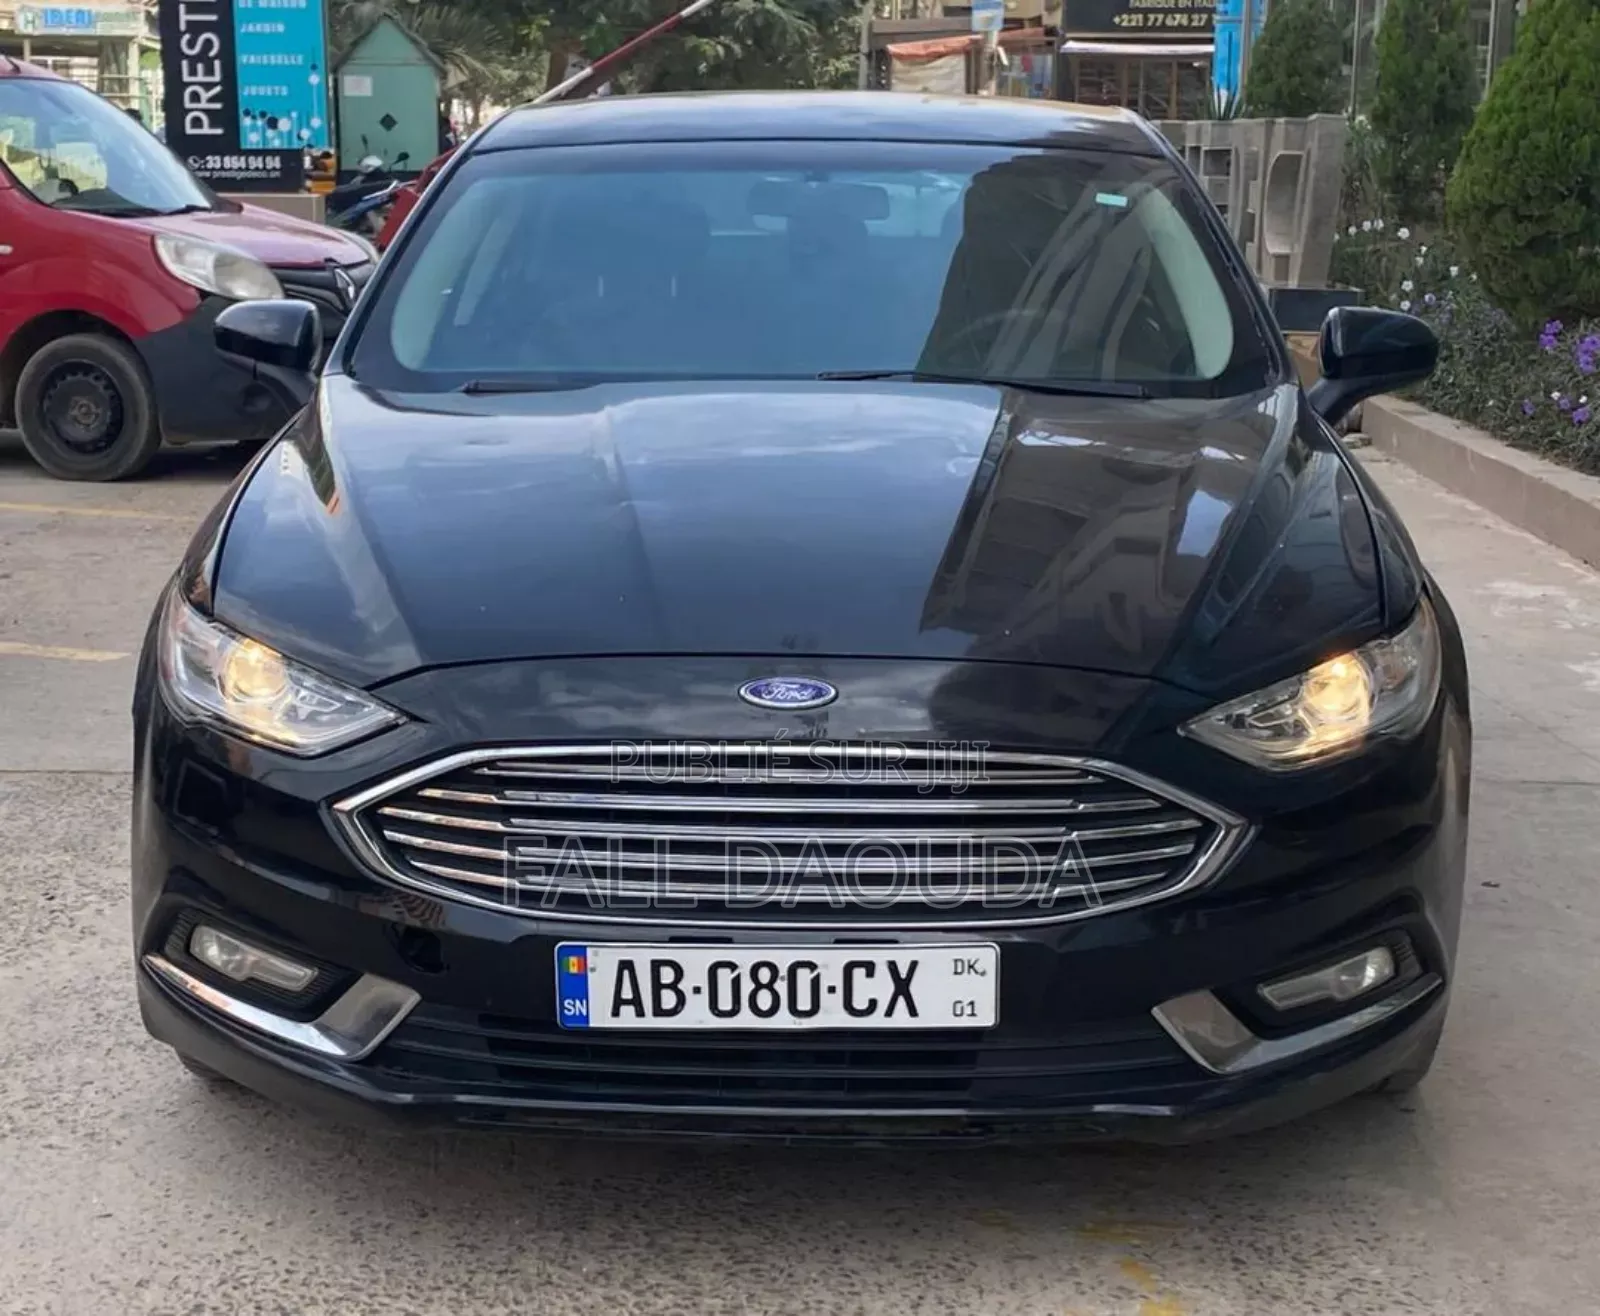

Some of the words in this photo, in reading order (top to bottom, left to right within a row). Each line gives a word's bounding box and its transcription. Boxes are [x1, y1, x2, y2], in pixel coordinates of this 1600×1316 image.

[1113, 13, 1143, 26] +221
[1146, 13, 1164, 26] 77
[241, 55, 303, 65] VAISSELLE
[179, 0, 224, 135] PREST
[243, 86, 288, 96] JOUETS
[563, 1000, 587, 1017] SN
